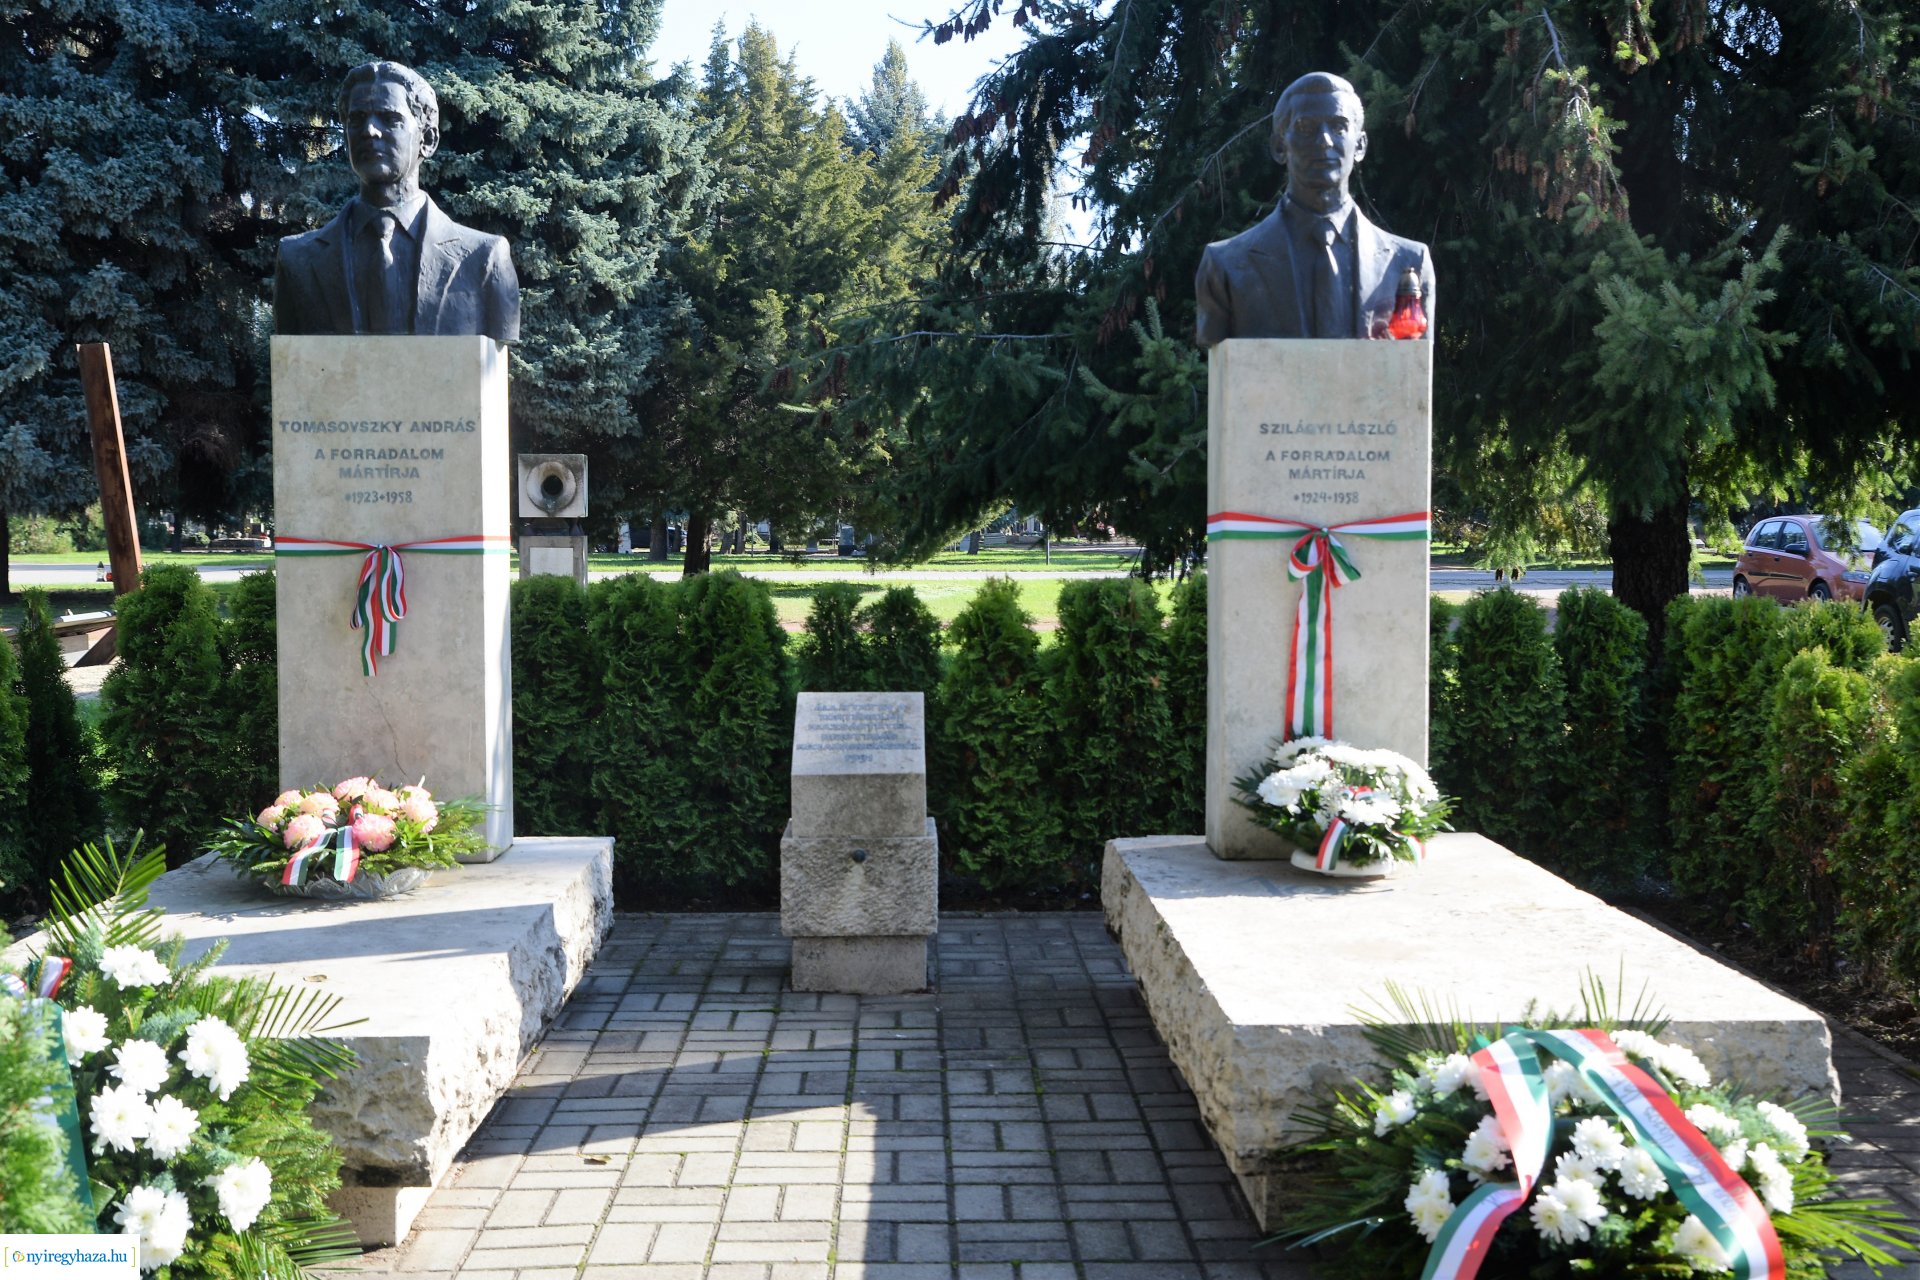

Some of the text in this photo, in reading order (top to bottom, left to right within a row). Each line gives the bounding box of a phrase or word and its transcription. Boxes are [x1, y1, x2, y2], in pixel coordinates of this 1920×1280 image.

[279, 417, 476, 433] TOMASOVSZKY ANDRÁS
[1259, 419, 1398, 435] SZILÁGYI LÁSZLÓ
[314, 448, 445, 460] A FORRADALOM
[1265, 450, 1391, 461] A FORRADALOM
[339, 463, 420, 479] MÁRTÍRJA
[1288, 466, 1366, 480] MÁRTÍRJA
